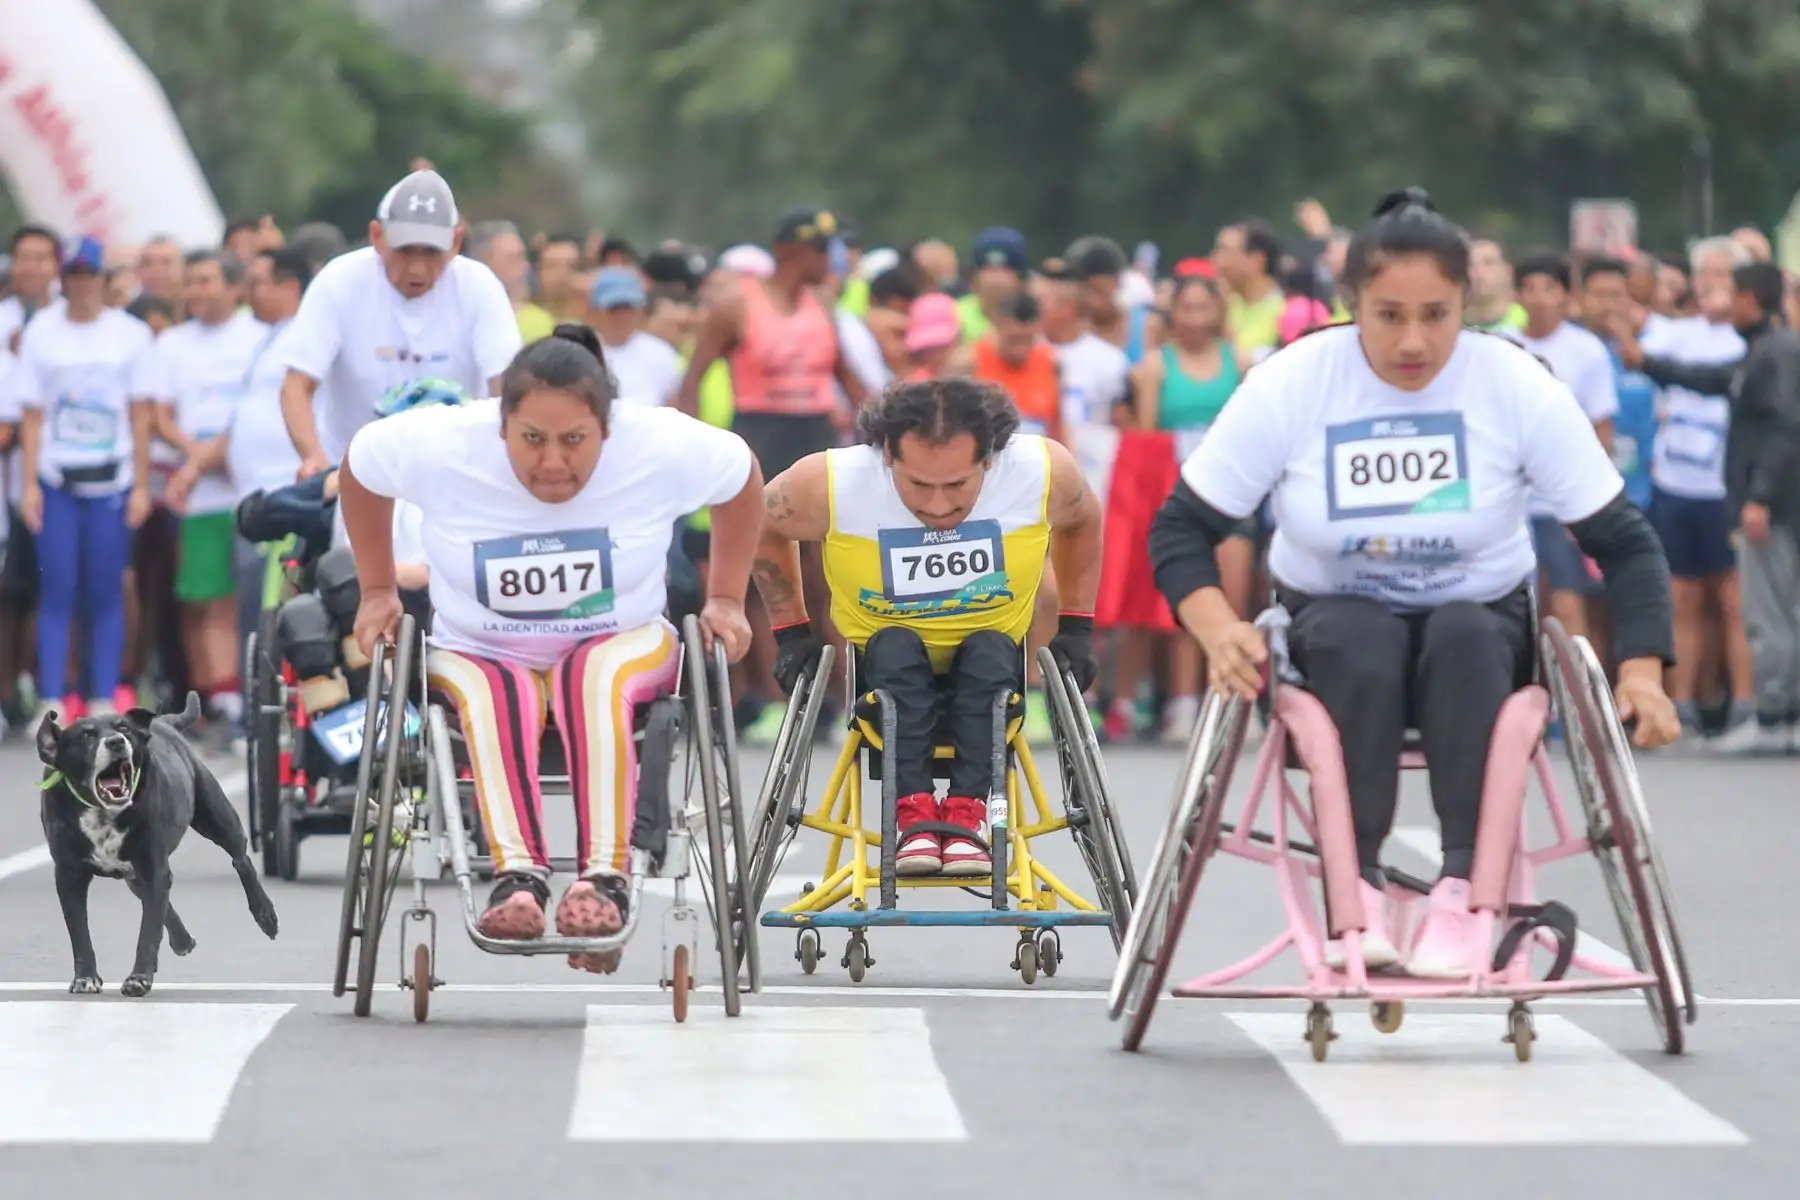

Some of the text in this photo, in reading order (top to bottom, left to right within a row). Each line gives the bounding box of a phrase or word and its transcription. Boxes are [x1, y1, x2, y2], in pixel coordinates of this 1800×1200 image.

[1350, 450, 1451, 486] 8002
[500, 562, 595, 597] 8017
[902, 549, 989, 581] 7660
[483, 620, 618, 634] LA IDENTIDAD ANDINA
